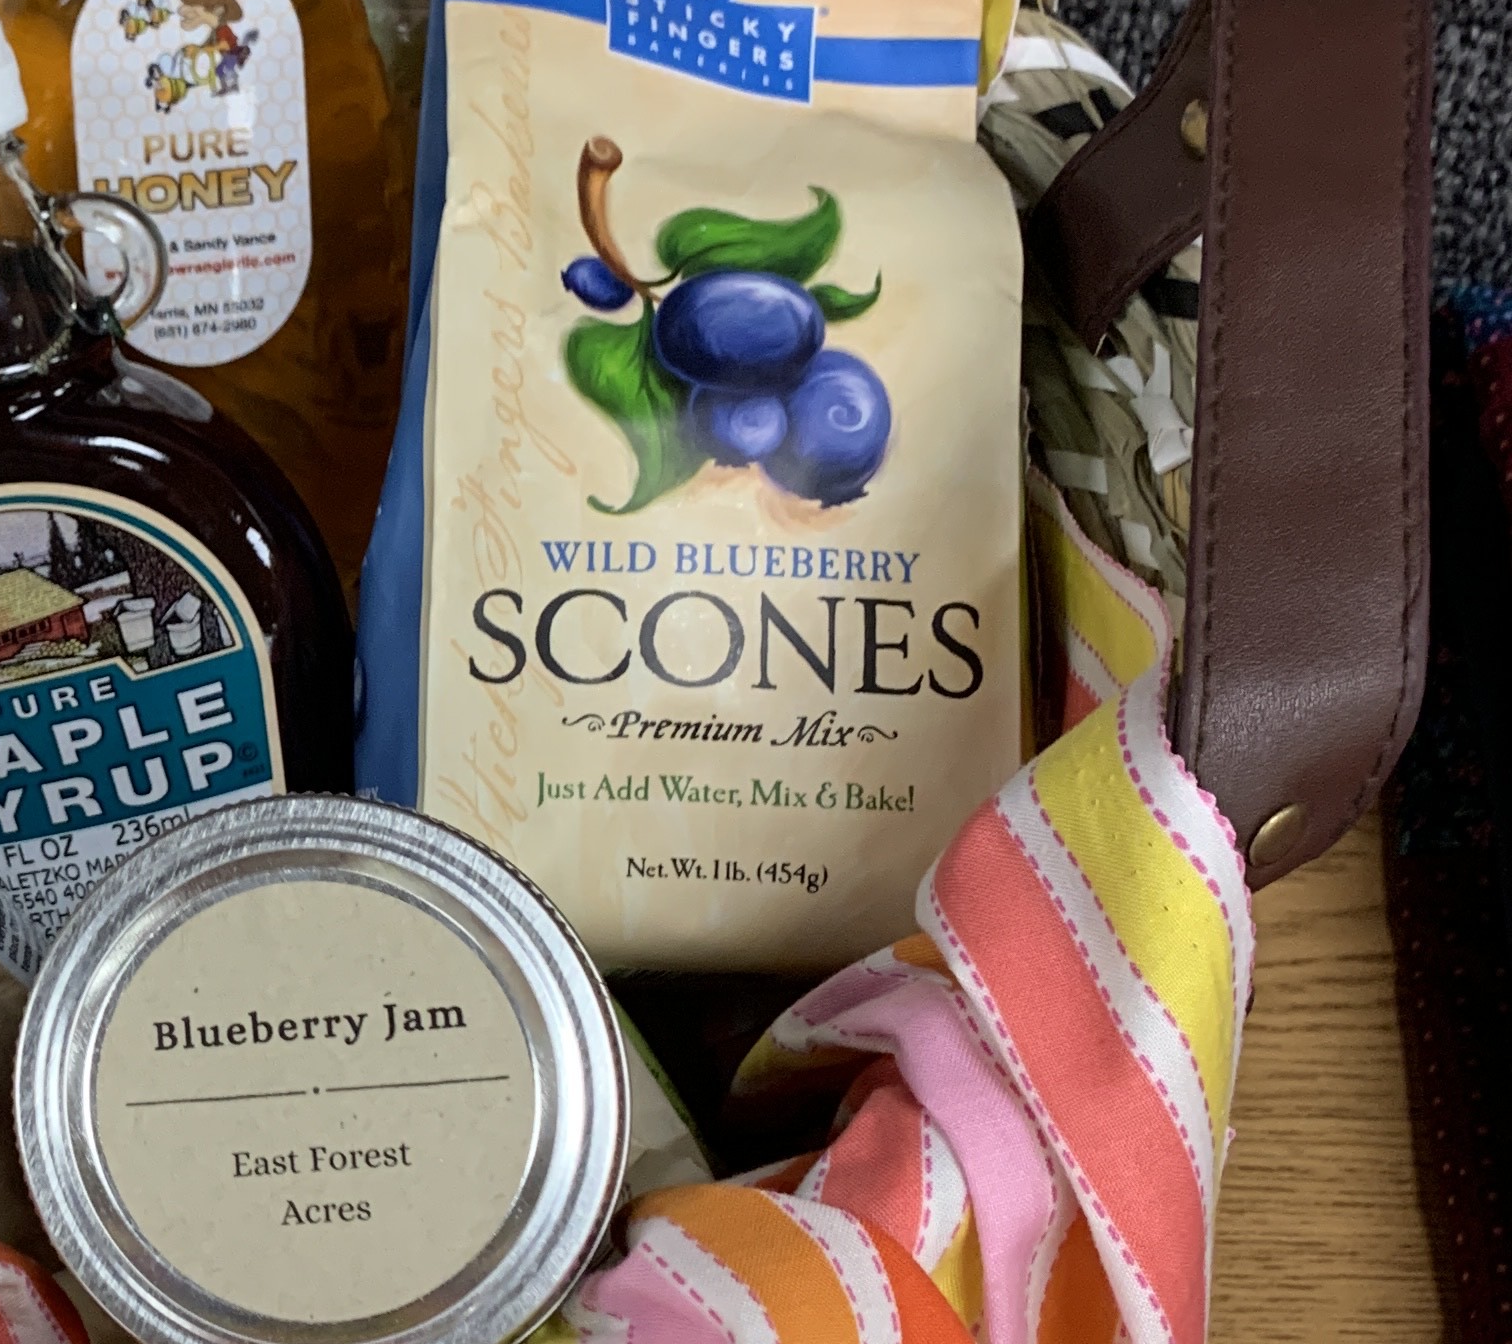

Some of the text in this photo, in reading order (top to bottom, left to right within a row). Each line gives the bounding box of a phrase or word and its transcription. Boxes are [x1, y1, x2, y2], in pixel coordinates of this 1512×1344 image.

[626, 9, 795, 72] FINGERS
[143, 126, 253, 165] PURE
[194, 302, 220, 317] MN
[541, 540, 921, 585] WILD BLUEBERRY
[467, 587, 985, 700] SCONES
[605, 711, 855, 748] Premium Mix
[536, 772, 916, 813] Just Add Water, Mix & Bake!
[4, 842, 35, 868] FL
[40, 833, 79, 861] OZ
[626, 857, 830, 895] Net. Wt. 1 lb. (454g)
[153, 1002, 467, 1052] Blueberry Jam
[231, 1142, 413, 1178] East Forest
[280, 1199, 373, 1227] Acres
